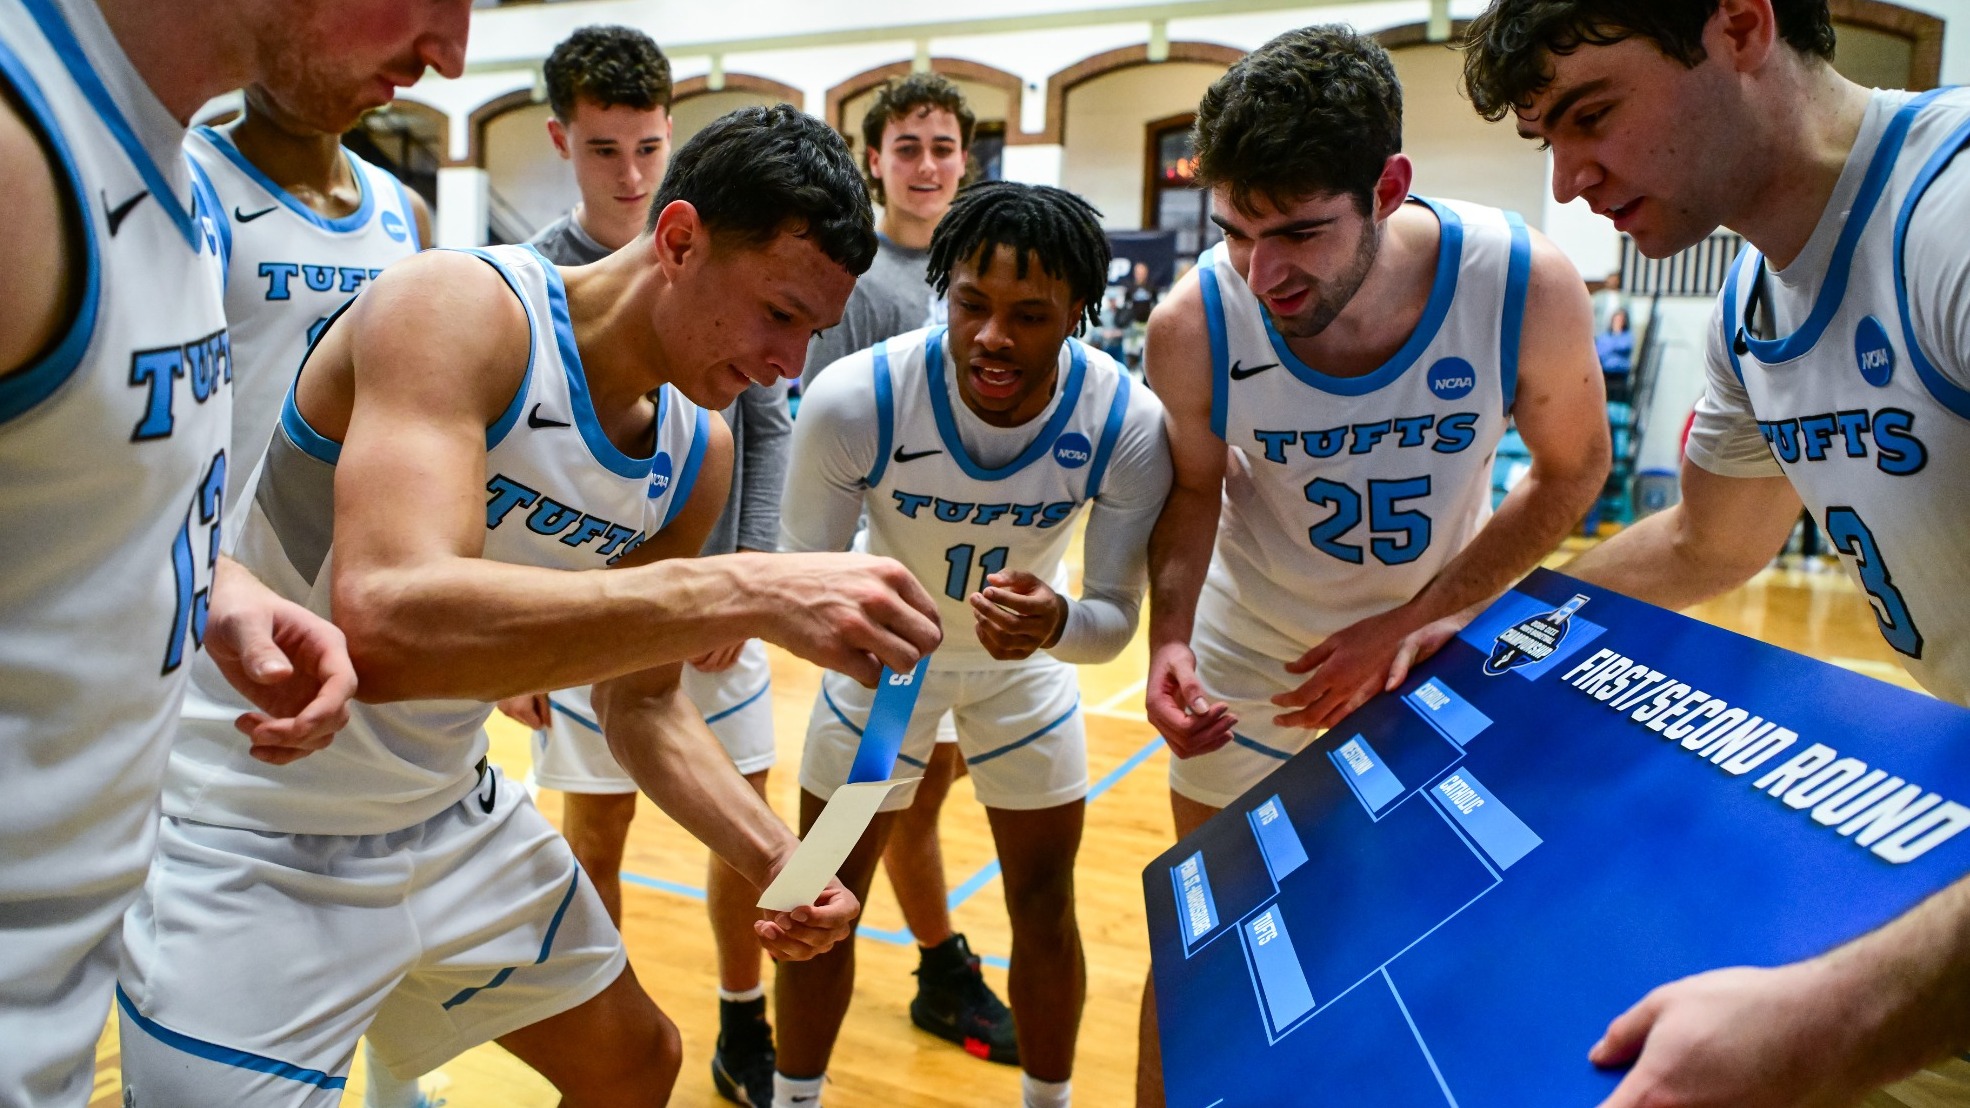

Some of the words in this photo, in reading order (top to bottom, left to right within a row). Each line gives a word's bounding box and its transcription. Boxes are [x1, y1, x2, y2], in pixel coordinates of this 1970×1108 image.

[1435, 377, 1473, 390] NCAA
[1057, 448, 1088, 462] NCAA
[1253, 412, 1480, 465] TUFTS
[892, 489, 1076, 529] TUFTS
[1303, 474, 1432, 566] 25
[944, 543, 1010, 603] 11
[1825, 505, 1924, 661] 3
[1499, 627, 1554, 659] CHAMPIONSHIP
[1414, 682, 1451, 711] CATHOLIC
[1561, 648, 1799, 776] FIRST/SECOND
[1752, 743, 1970, 865] ROUND
[1257, 800, 1279, 826] TUFTS
[1439, 775, 1485, 815] CATHOLIC
[1252, 911, 1278, 946] TUFTS
